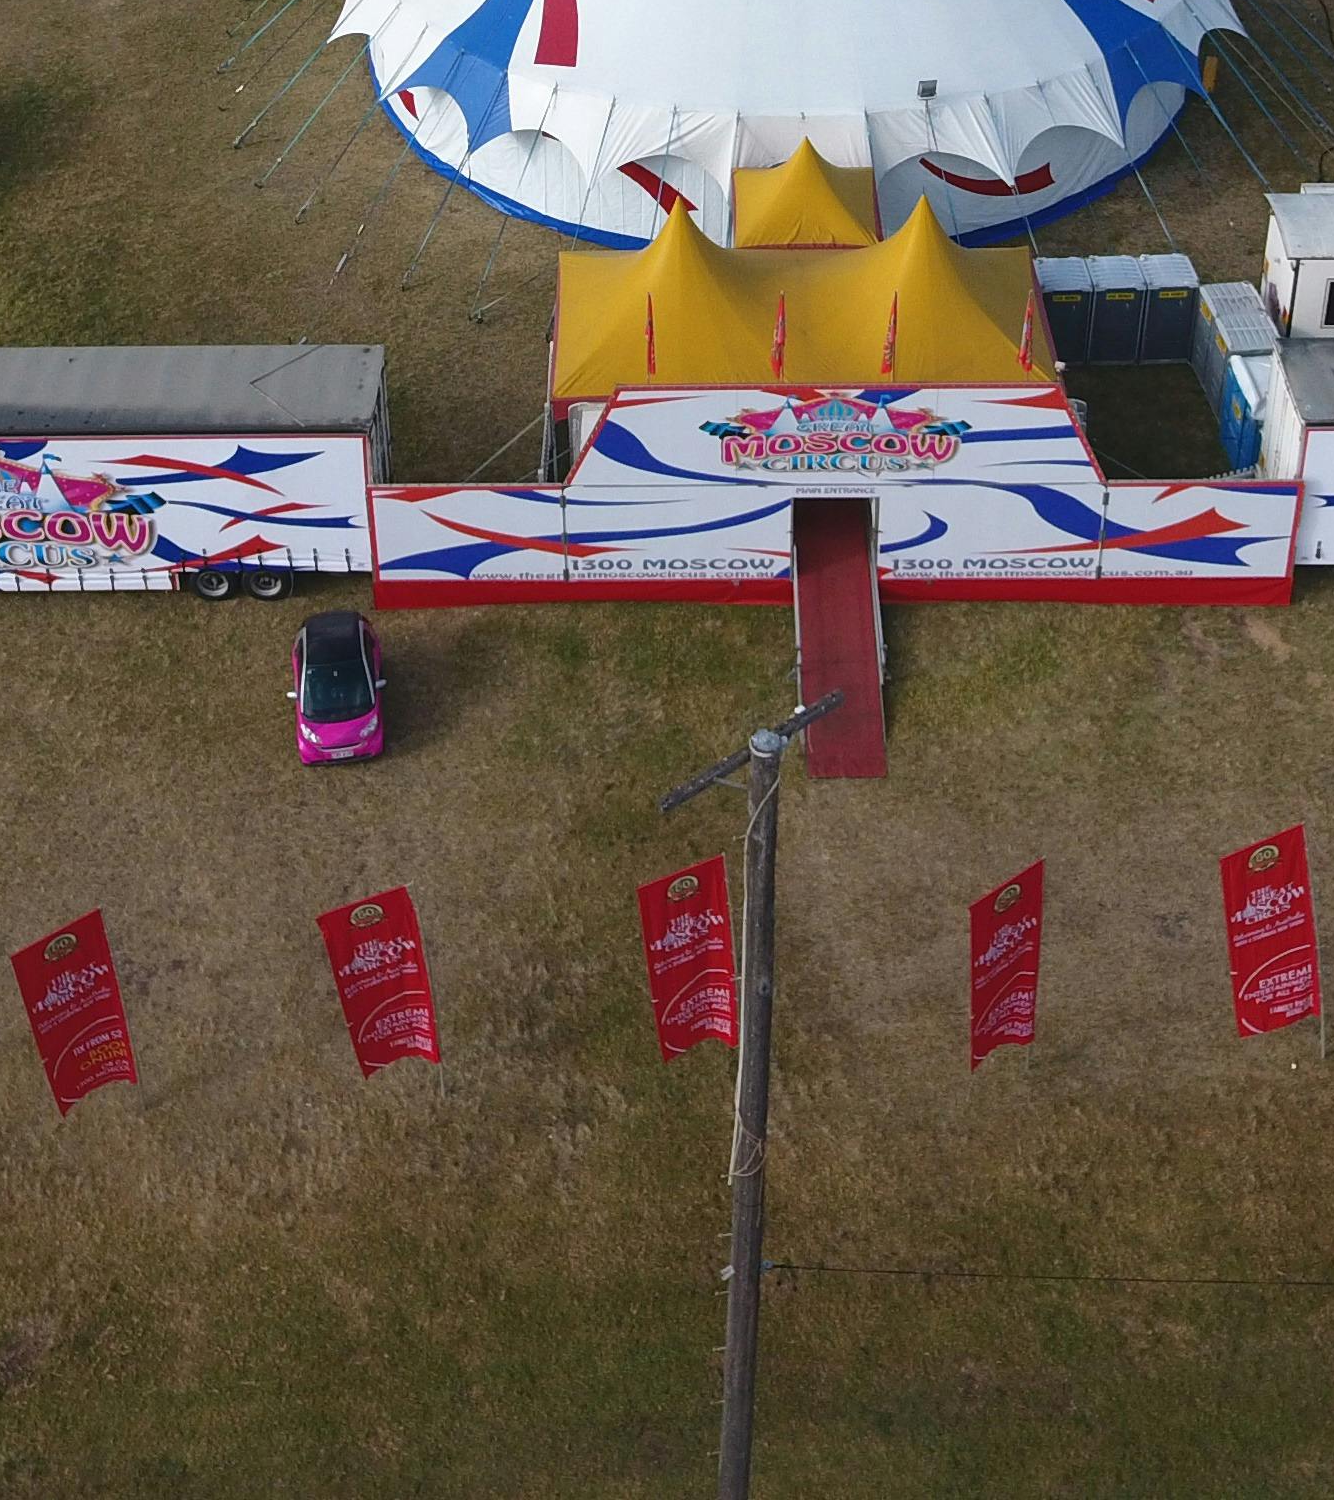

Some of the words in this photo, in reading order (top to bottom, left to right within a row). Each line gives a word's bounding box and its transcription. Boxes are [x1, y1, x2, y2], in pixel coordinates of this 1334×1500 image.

[796, 420, 875, 433] GREAT
[721, 432, 958, 463] MOSCOW
[761, 454, 909, 472] CIRCUS
[795, 487, 822, 495] MAIN
[571, 559, 633, 571] 1300
[643, 558, 776, 571] MOSCOW
[892, 558, 953, 570] 1300
[963, 557, 1095, 570] MOSCOW
